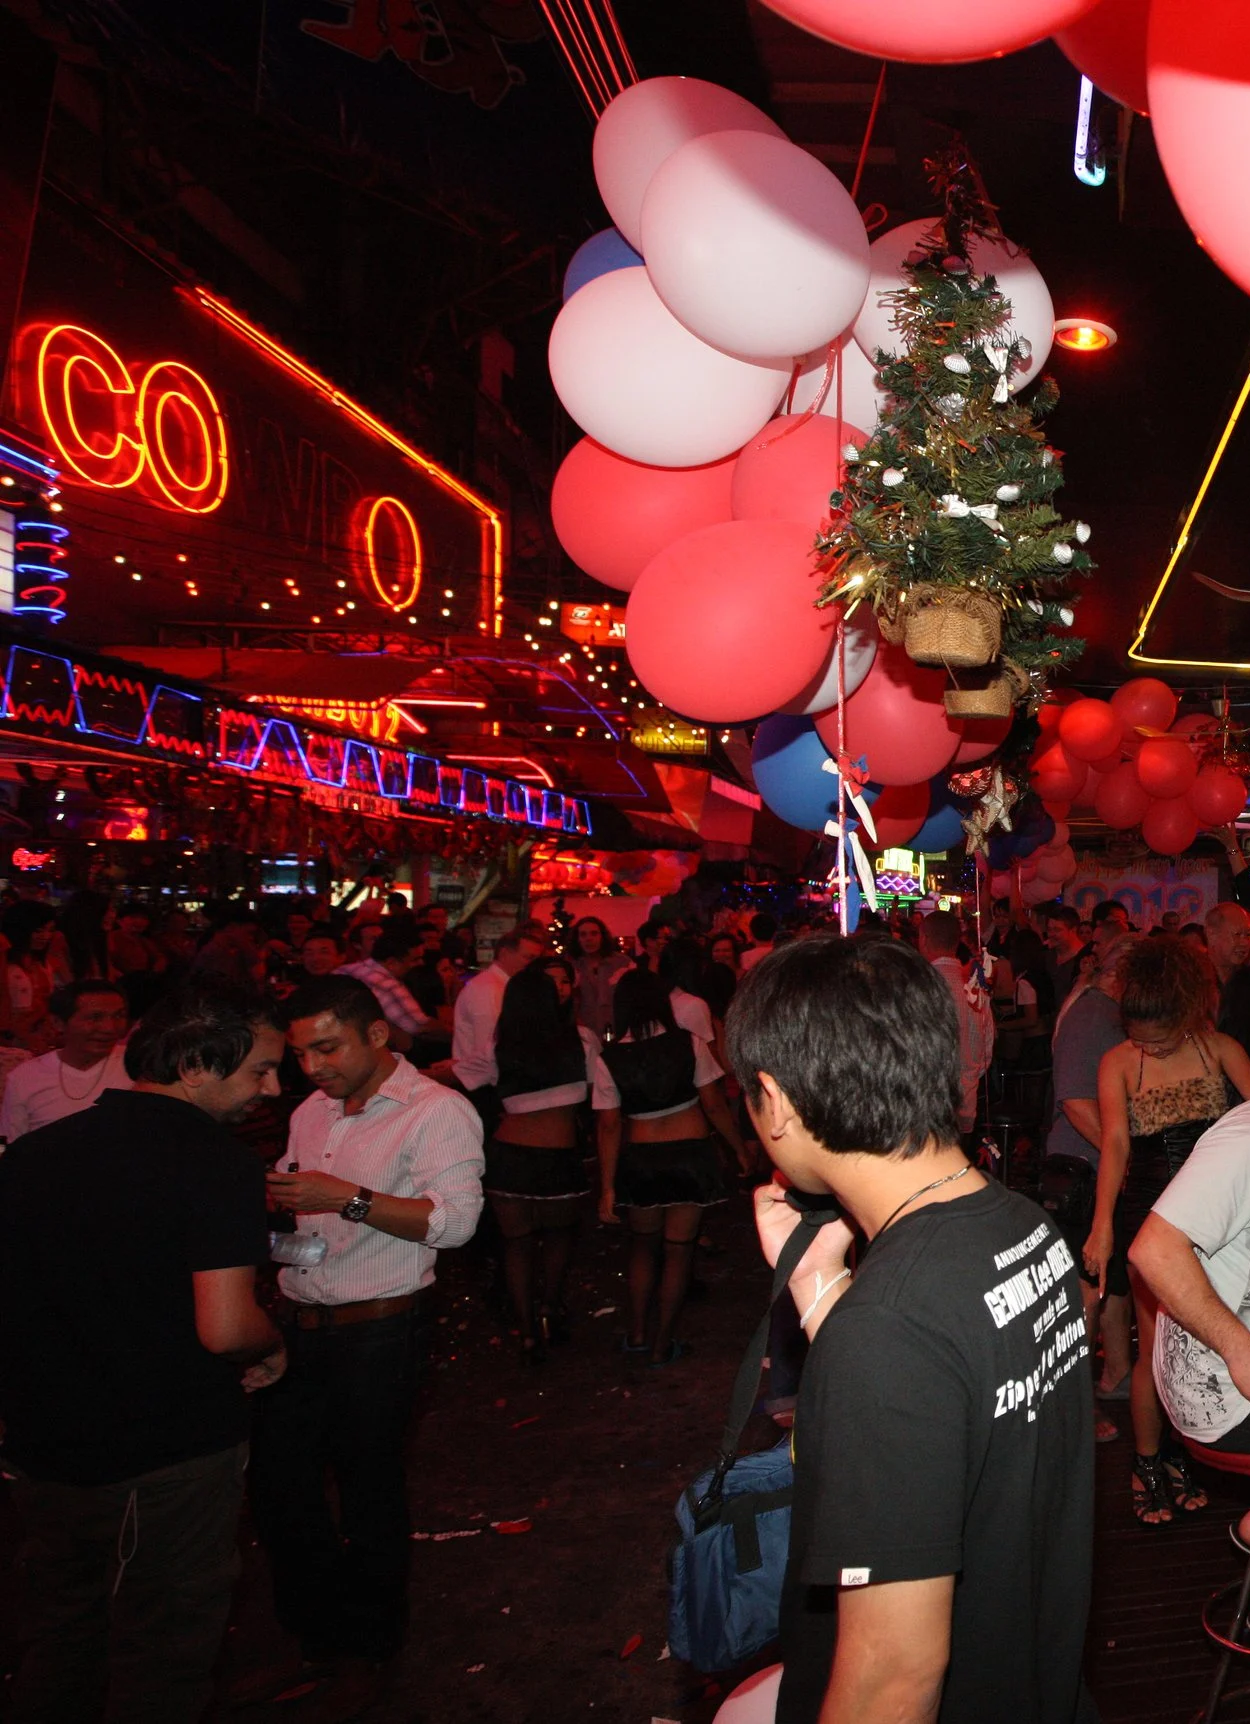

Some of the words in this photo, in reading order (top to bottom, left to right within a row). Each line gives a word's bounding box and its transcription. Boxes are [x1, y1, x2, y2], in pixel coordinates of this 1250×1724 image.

[608, 622, 627, 638] AT
[983, 1267, 1038, 1329] GENUINE
[1030, 1260, 1053, 1297] Lee
[847, 1573, 863, 1584] Lee
